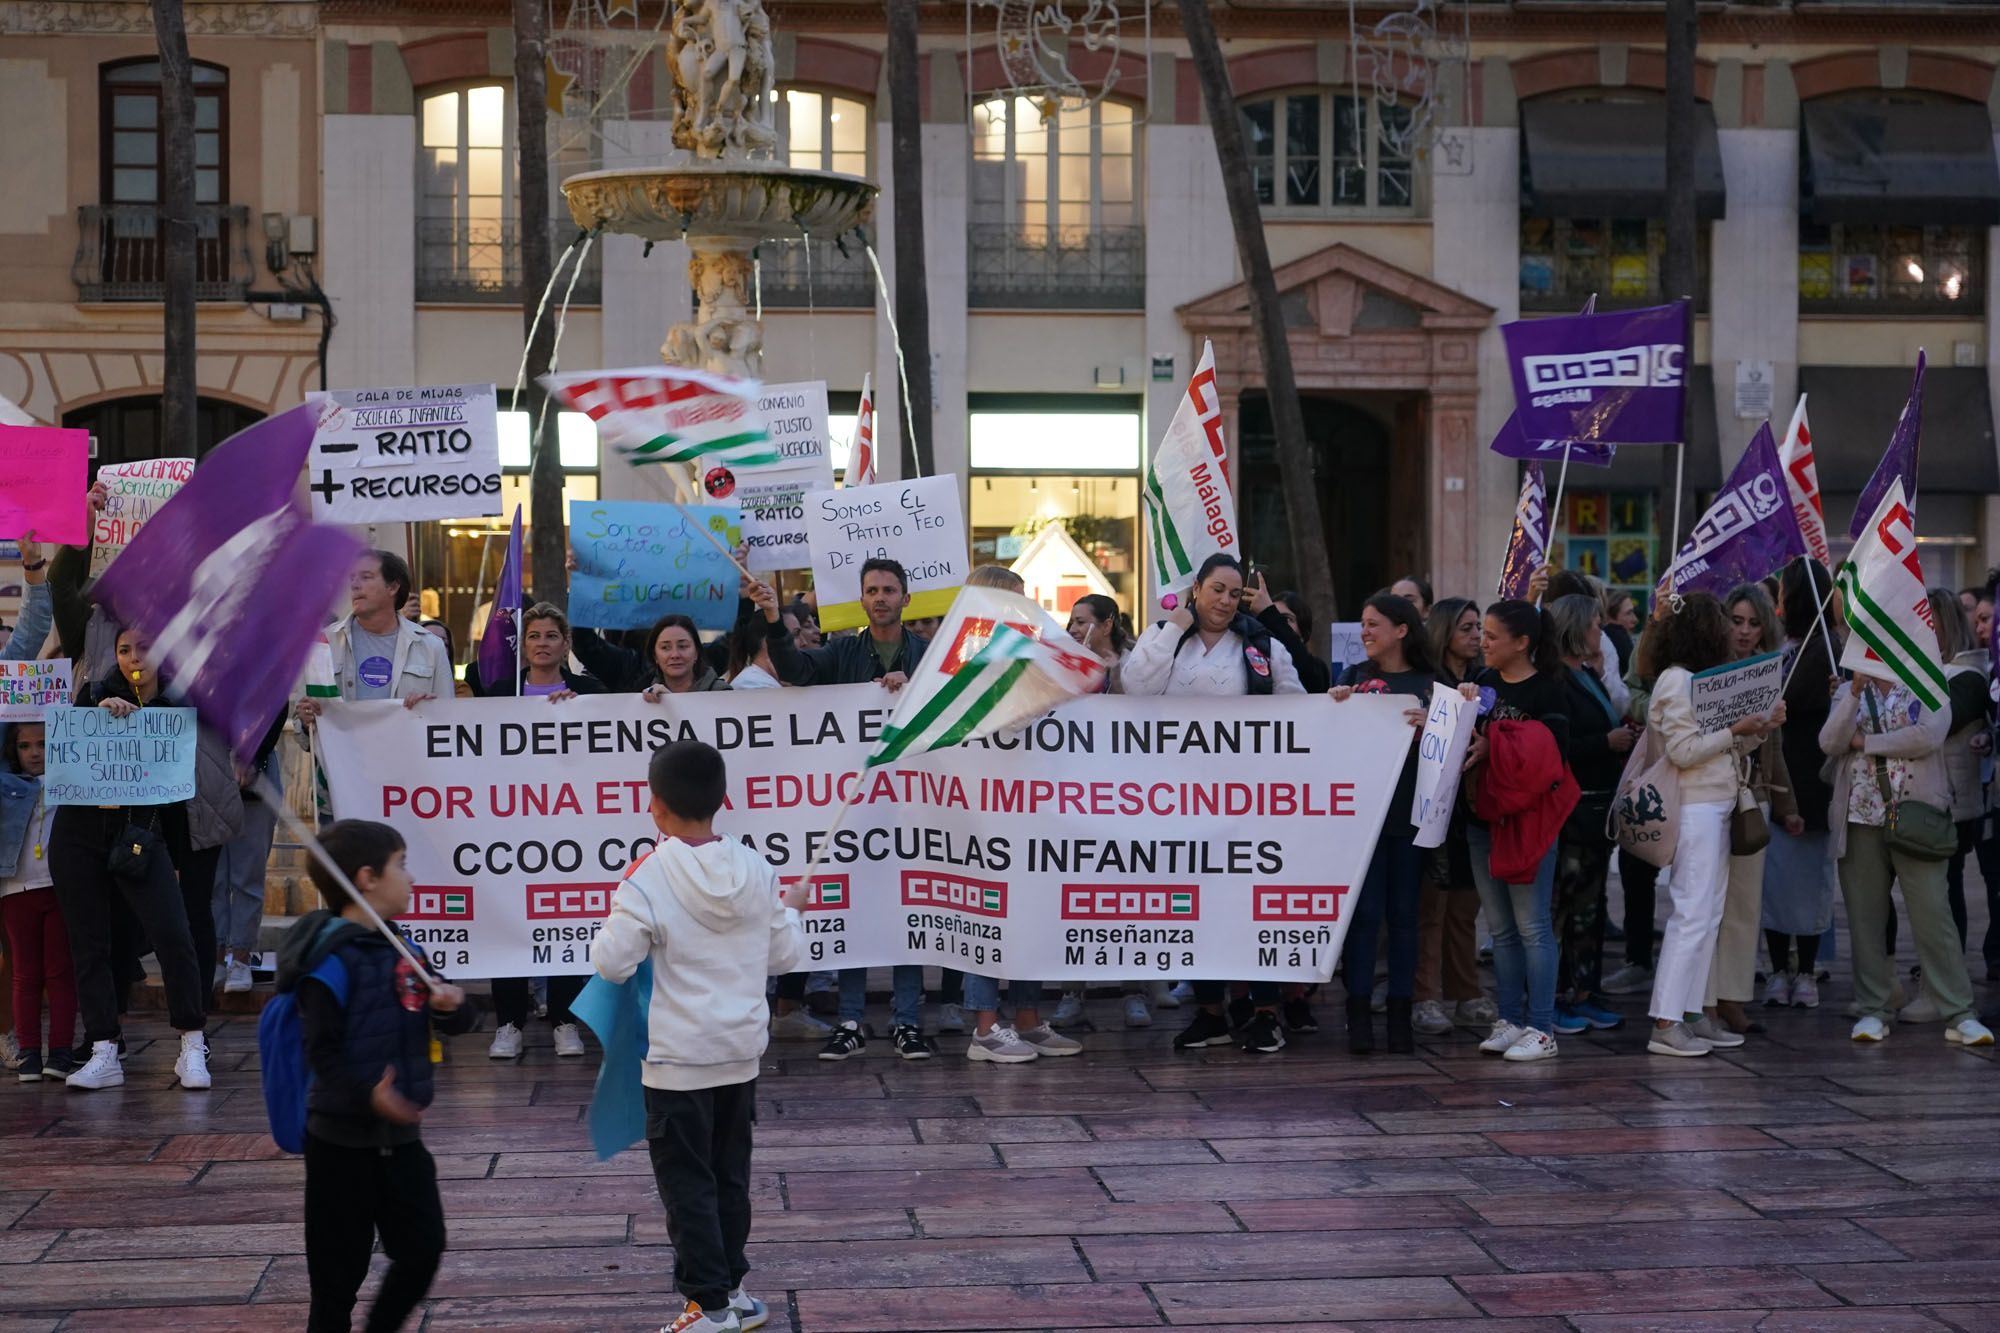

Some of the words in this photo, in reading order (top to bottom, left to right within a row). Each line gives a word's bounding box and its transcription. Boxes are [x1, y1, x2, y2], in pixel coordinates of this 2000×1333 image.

[356, 392, 389, 403] CALA
[396, 390, 413, 400] DE
[420, 387, 463, 400] MIJAS
[355, 410, 403, 427] ESCUELAS
[409, 405, 463, 424] INFANTILES
[773, 416, 813, 435] JUSTO
[375, 427, 473, 456] RATIO
[350, 472, 502, 499] RECURSOS
[900, 488, 926, 509] EL
[1190, 462, 1234, 548] Málaga
[754, 505, 804, 522] RATIO
[839, 522, 903, 542] PATITO
[907, 508, 945, 532] FEO
[827, 551, 855, 570] DE
[602, 577, 724, 604] EDUCACIÓN
[17, 662, 54, 678] POLLO
[44, 676, 68, 690] PARA
[83, 711, 138, 737] QUEDA
[426, 724, 483, 758] EN
[499, 718, 699, 757] DEFENSA
[714, 714, 774, 750] DE
[789, 711, 846, 746] LA
[1110, 719, 1311, 755] INFANTIL
[49, 742, 81, 764] MES
[106, 739, 148, 763] FINAL
[154, 739, 182, 763] DEL
[382, 784, 476, 819] POR
[489, 782, 584, 818] UNA
[745, 769, 970, 811] EDUCATIVA
[980, 777, 1357, 818] IMPRESCINDIBLE
[452, 839, 584, 877] CCOO
[805, 827, 1012, 872] ESCUELAS
[1027, 839, 1284, 874] INFANTILES
[906, 912, 1002, 941] enseñanza
[1065, 924, 1195, 944] enseñanza
[907, 930, 1002, 964] Málaga
[1064, 946, 1195, 971] Málaga
